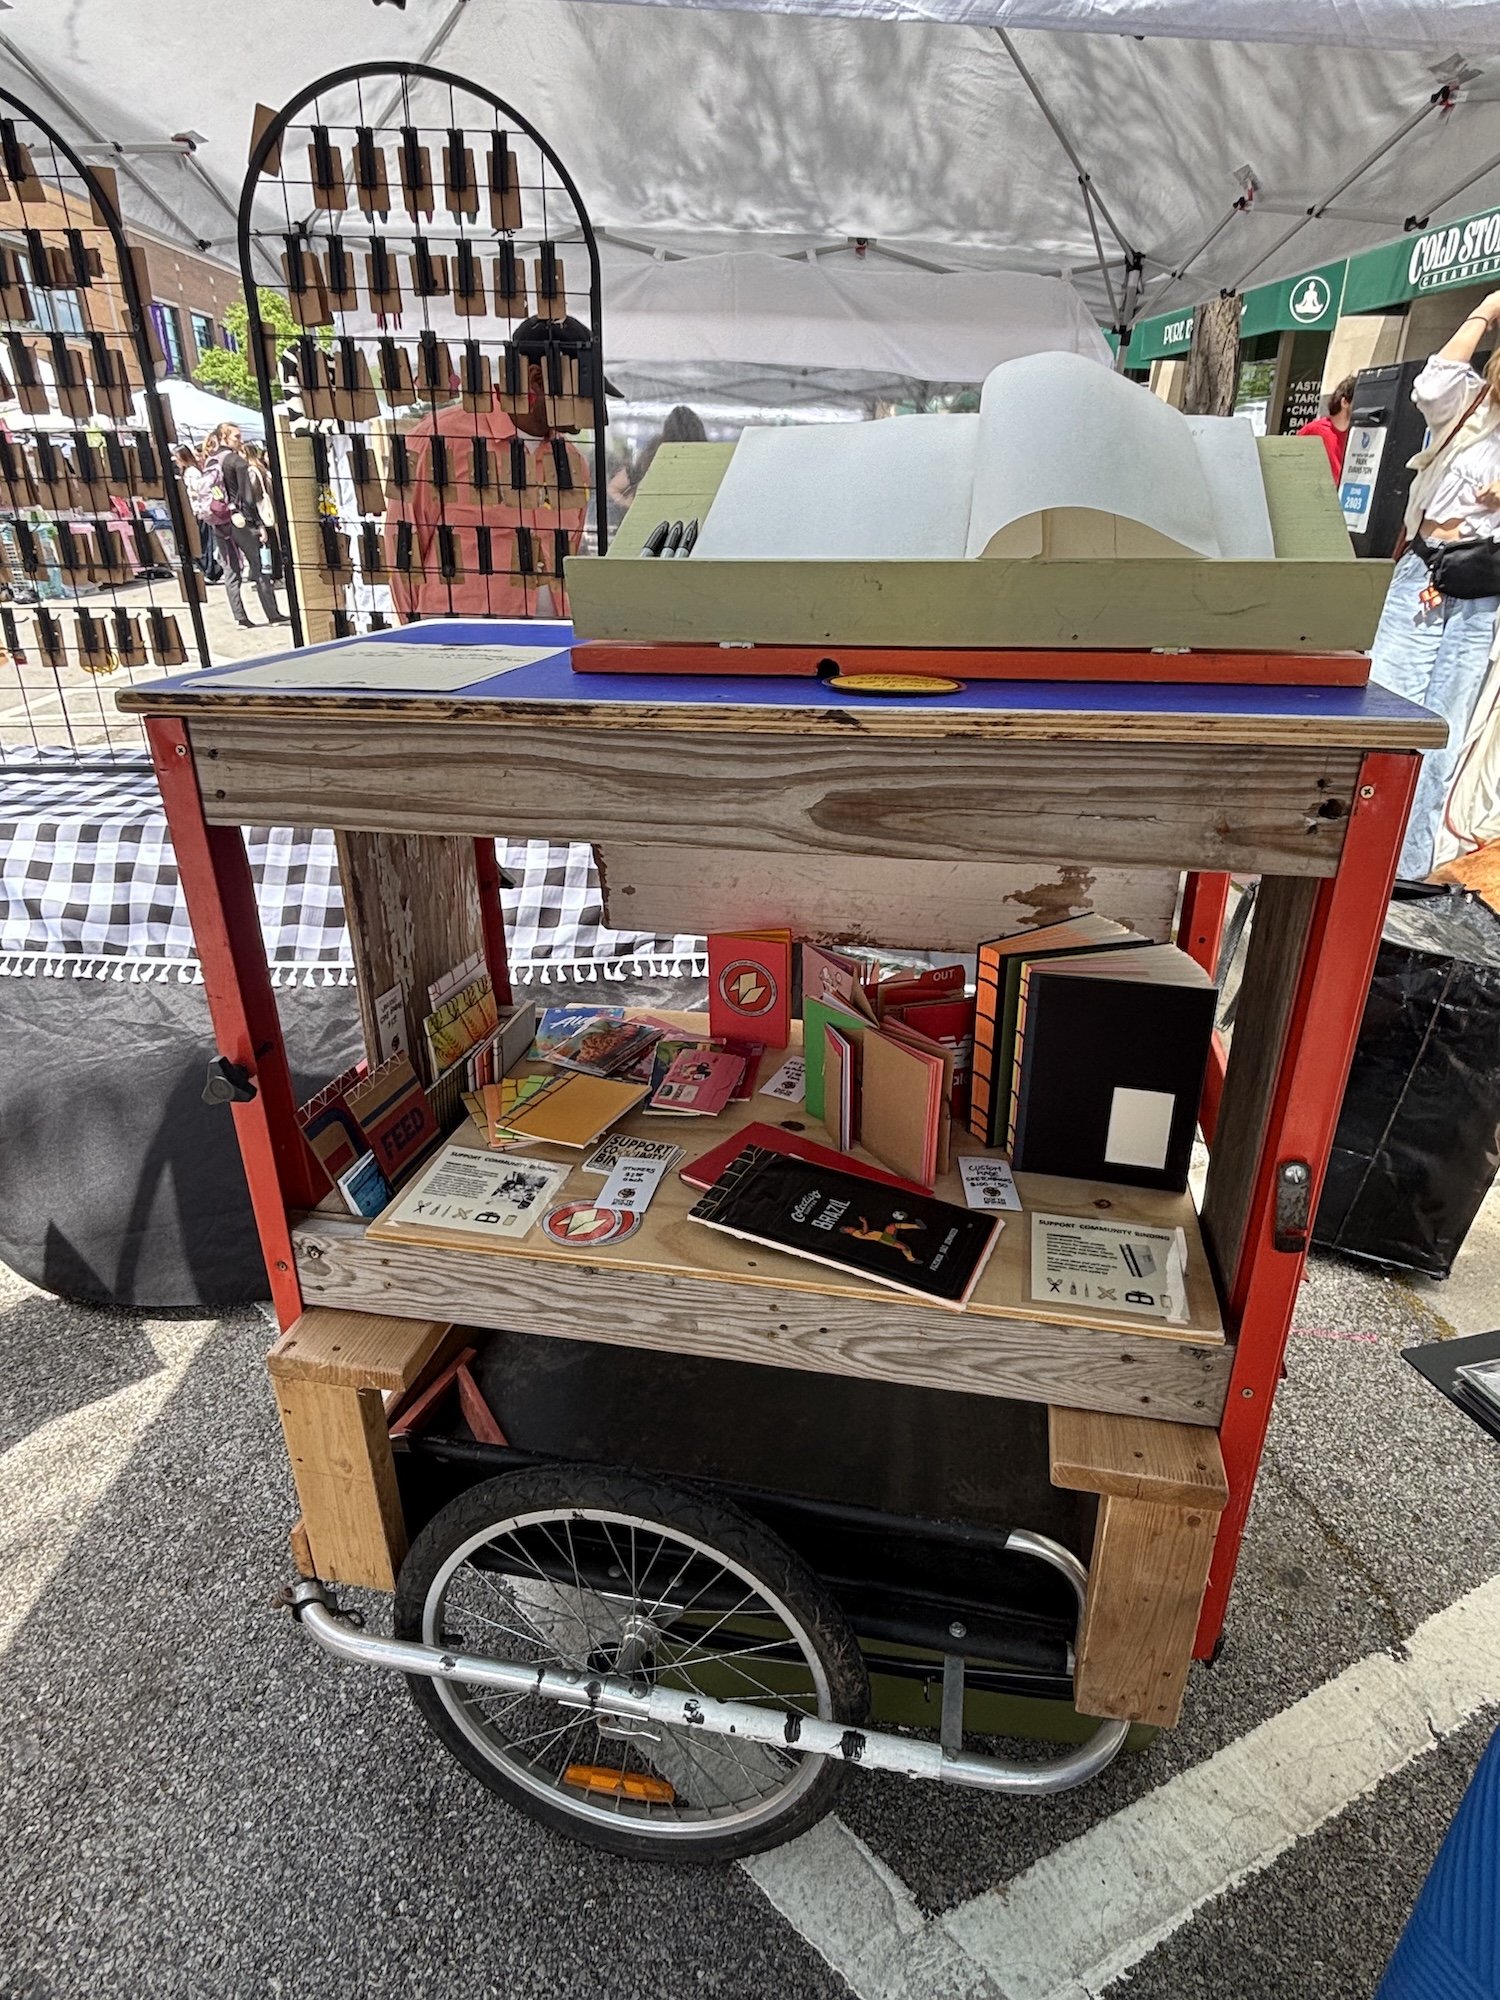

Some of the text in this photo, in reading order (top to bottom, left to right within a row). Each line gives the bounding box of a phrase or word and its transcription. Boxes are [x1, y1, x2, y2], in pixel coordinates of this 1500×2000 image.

[1408, 227, 1461, 285] COLD
[932, 968, 956, 982] OUT
[381, 1106, 425, 1160] FEED
[610, 1135, 673, 1155] SUPPORT
[450, 1151, 482, 1162] SUPPORT
[968, 1164, 1002, 1172] CUSTOM
[811, 1198, 851, 1231] BRAZIL
[1038, 1218, 1171, 1241] SUPPORT COMMUNITY BINDING
